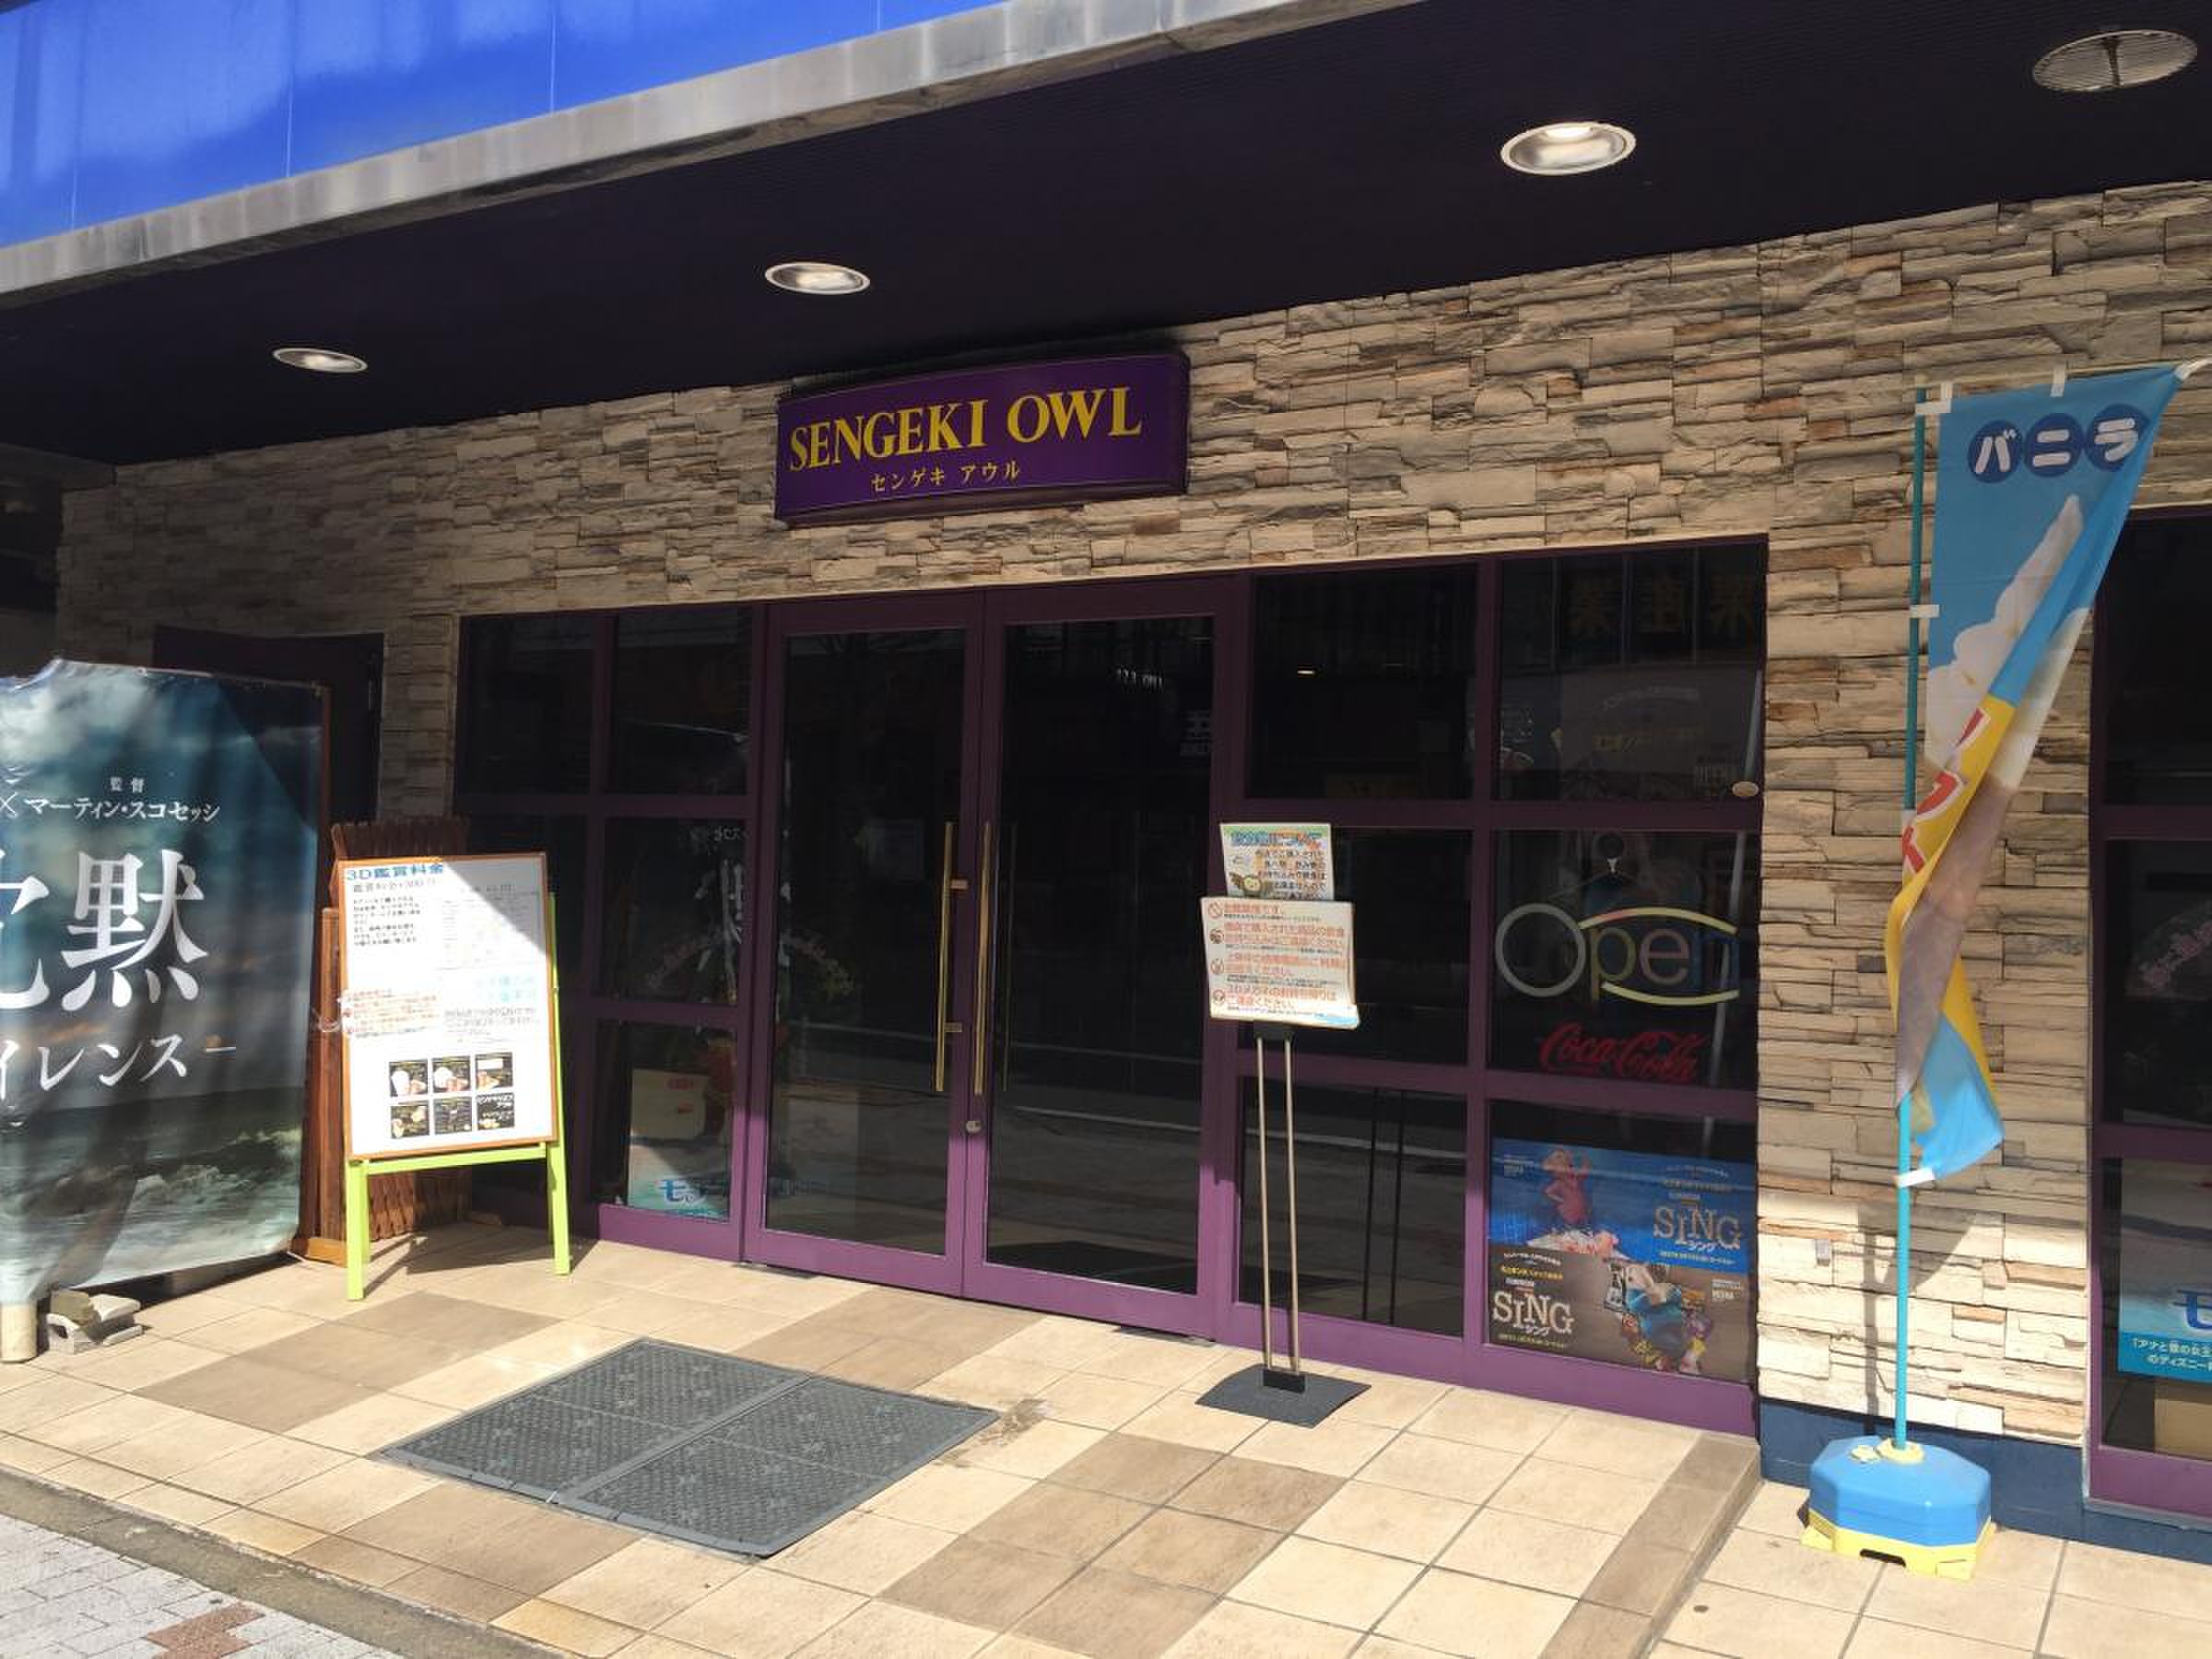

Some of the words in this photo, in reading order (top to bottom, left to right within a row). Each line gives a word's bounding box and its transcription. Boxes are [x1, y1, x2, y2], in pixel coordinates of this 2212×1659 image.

[790, 399, 988, 472] SENGEKI
[1007, 386, 1142, 443] OWL
[1974, 418, 2139, 475] バニラ
[871, 468, 946, 492] センゲキ
[959, 460, 1020, 485] アウル
[1495, 902, 1740, 1005] Open
[1653, 1206, 1743, 1251] SING
[1492, 1290, 1575, 1335] SING
